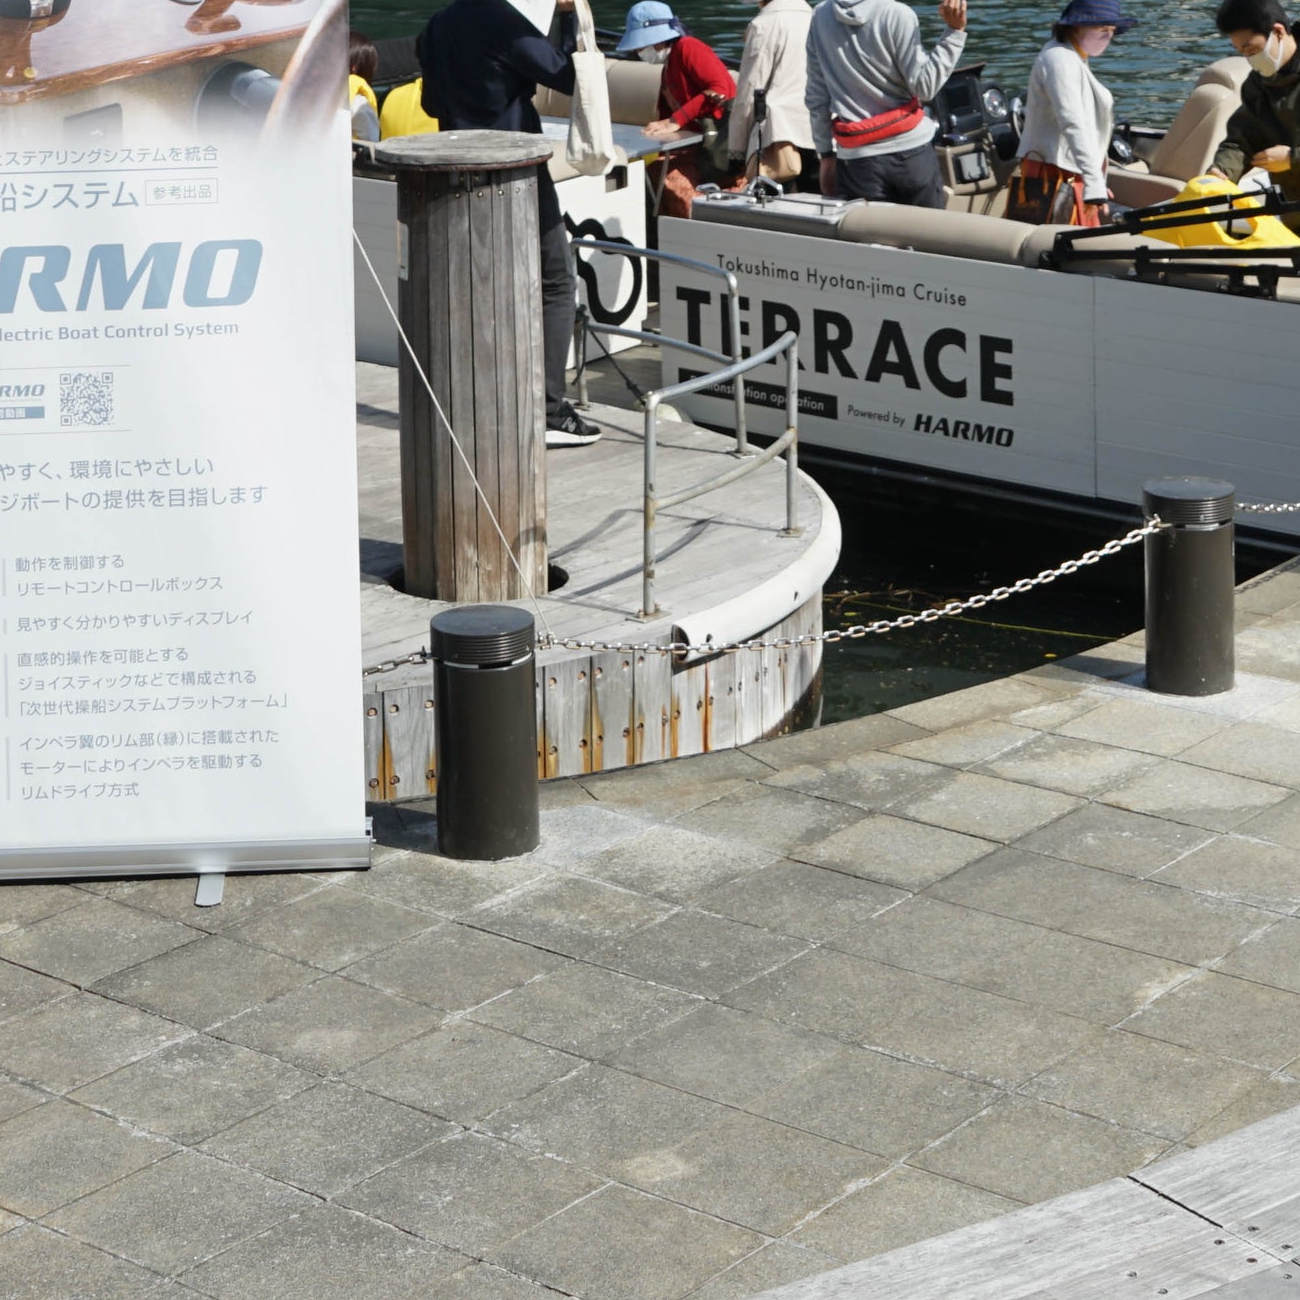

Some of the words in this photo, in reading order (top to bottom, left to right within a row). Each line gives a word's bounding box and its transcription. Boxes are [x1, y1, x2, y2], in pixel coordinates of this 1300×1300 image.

[153, 184, 212, 201] 参考出品
[717, 254, 799, 281] Tokushima
[806, 267, 906, 298] Hyotan-jima
[913, 283, 967, 306] Cruise
[58, 325, 100, 340] Boat
[104, 322, 169, 338] Control
[174, 321, 239, 338] System
[676, 286, 1014, 406] TERRACE
[847, 405, 890, 422] Powered
[893, 412, 906, 427] by
[913, 413, 1014, 448] HARMO
[15, 555, 125, 572] 動作を制御する
[17, 576, 224, 596] リモートコントロールボックス
[17, 611, 253, 632] 見やすく分かりやすいディスプレイ
[17, 648, 189, 667] 直感的操作を可能とする
[19, 670, 257, 691] ジョイスティックなどで構成される
[20, 693, 288, 717] 「次世代操船システムプラットフォーム」
[21, 782, 140, 801] リムドライブ方式
